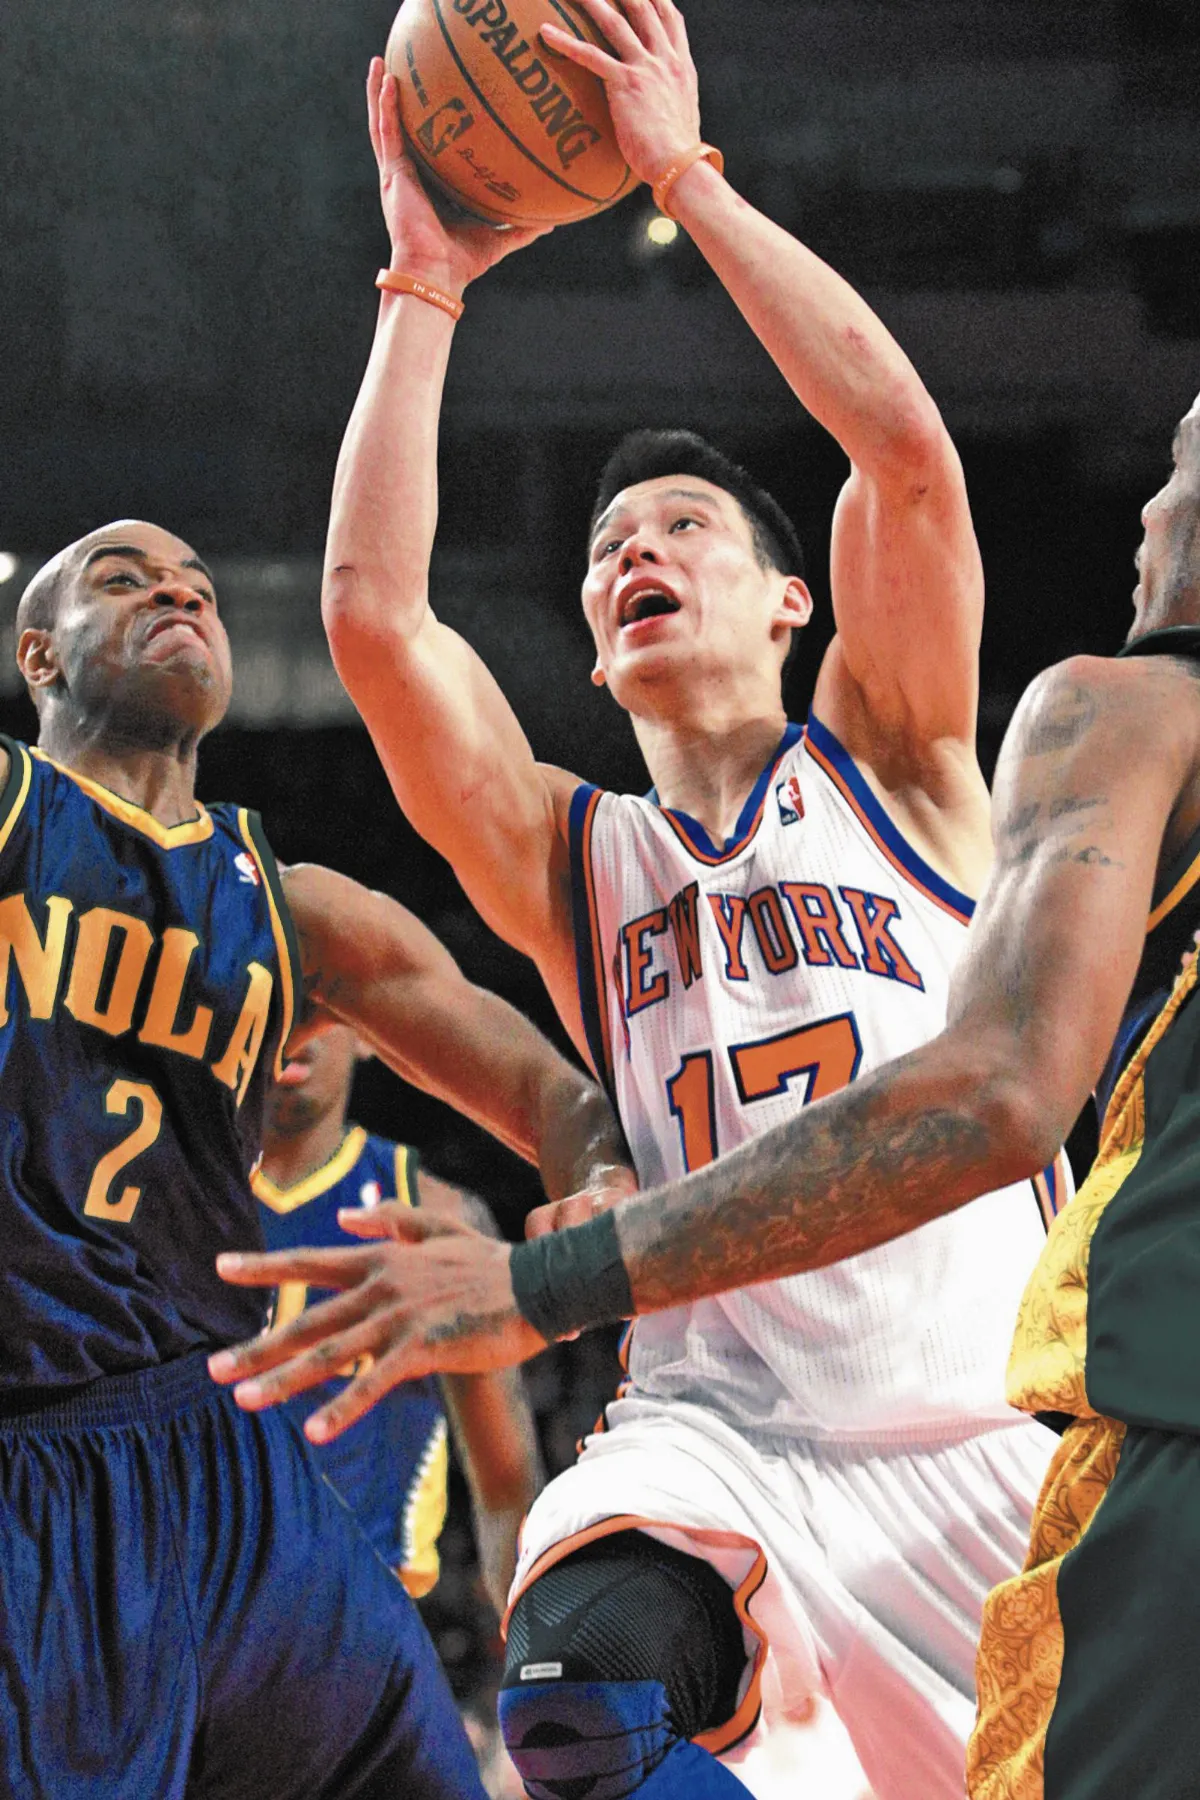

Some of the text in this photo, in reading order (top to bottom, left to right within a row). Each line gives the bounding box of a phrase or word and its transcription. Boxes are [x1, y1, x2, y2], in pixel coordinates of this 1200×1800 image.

[413, 282, 426, 294] IN
[0, 893, 273, 1108] NOLA
[706, 880, 926, 993] YORK
[83, 1078, 163, 1223] 2
[665, 1011, 864, 1175] 17
